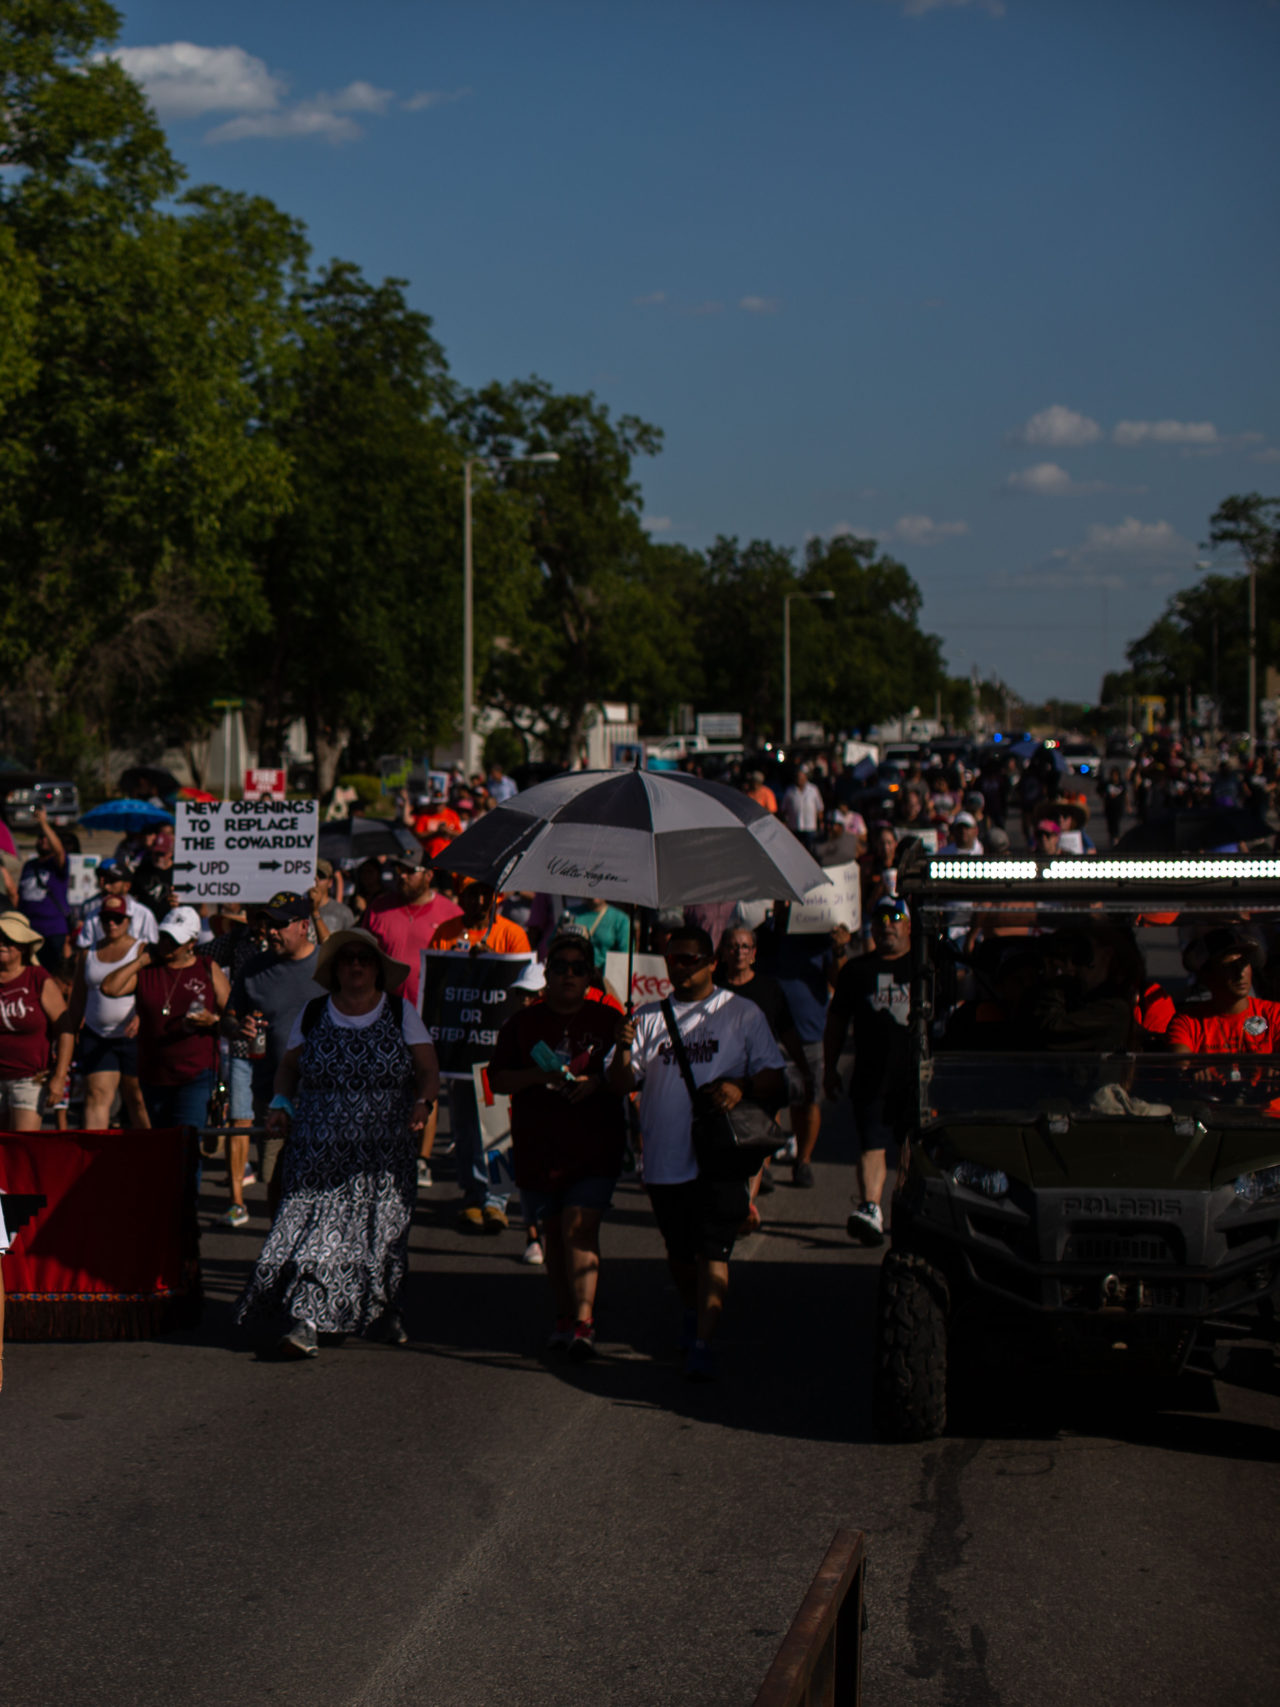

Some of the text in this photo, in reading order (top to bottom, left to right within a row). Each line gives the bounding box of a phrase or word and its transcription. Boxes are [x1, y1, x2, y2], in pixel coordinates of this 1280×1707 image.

[185, 800, 314, 815] NEW OPENINGS
[189, 817, 299, 833] TO REPLACE
[182, 835, 315, 850] THE COWARDLY
[199, 860, 312, 876] UPD DPS
[197, 882, 241, 896] UCISD
[444, 986, 508, 1005] STEP UP
[460, 1008, 483, 1024] OR
[429, 1026, 500, 1046] STEP ASI
[1062, 1197, 1182, 1216] POLARIS
